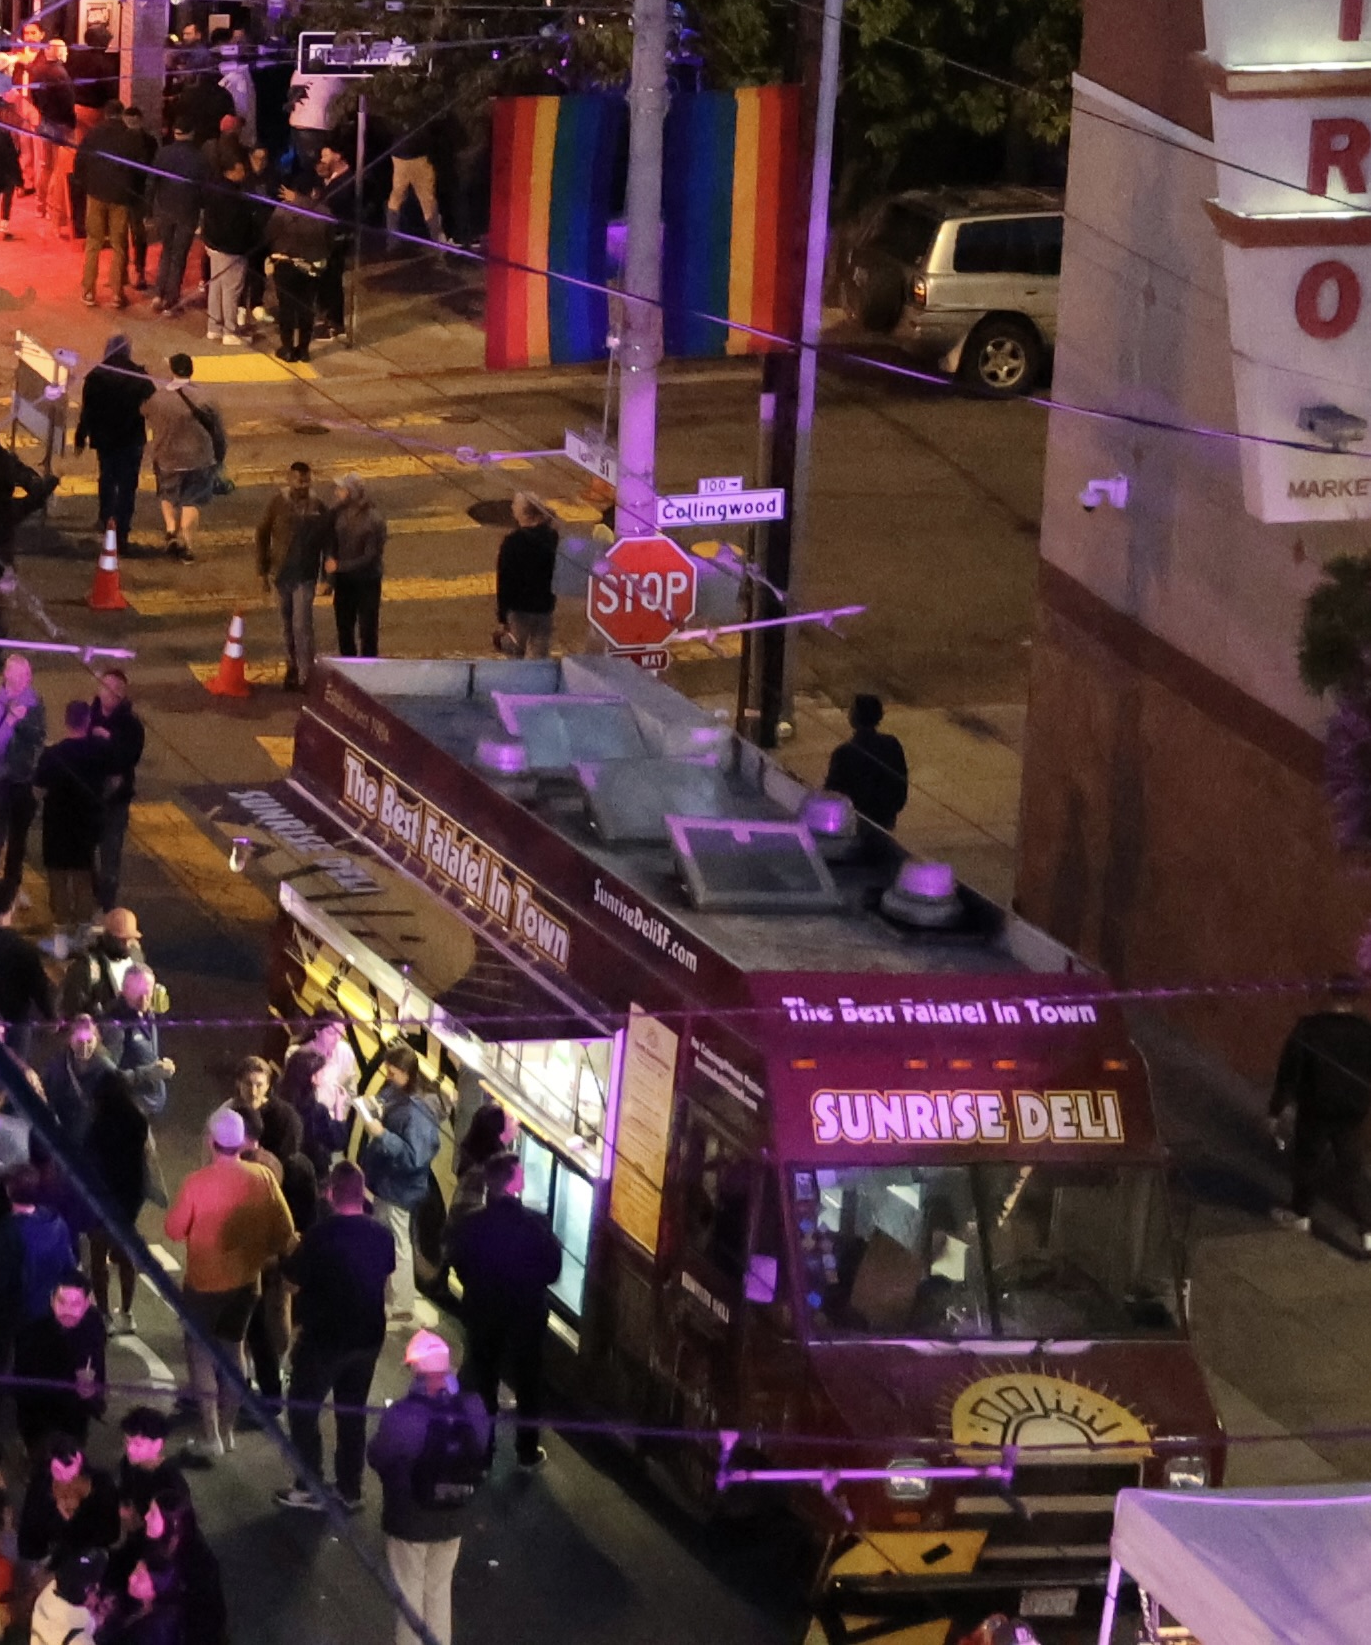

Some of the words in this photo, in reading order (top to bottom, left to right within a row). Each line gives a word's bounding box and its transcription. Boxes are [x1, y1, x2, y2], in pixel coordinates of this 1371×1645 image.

[703, 479, 726, 492] 100
[1287, 477, 1371, 498] MARKE
[662, 497, 776, 522] Collingwood
[597, 571, 688, 616] STOP
[641, 654, 664, 667] WAY
[227, 790, 336, 854] SUNRISE
[344, 754, 378, 815] The
[383, 780, 420, 845] Best
[424, 816, 487, 899] Falafel
[488, 865, 511, 919] In
[514, 884, 569, 964] Town
[593, 877, 698, 975] SunriseDeliSF.com
[782, 996, 834, 1022] The
[837, 997, 895, 1023] Best
[900, 999, 987, 1024] Falafel
[992, 1000, 1021, 1024] In
[1024, 999, 1097, 1024] Town
[813, 1092, 1007, 1141] SUNRISE
[1016, 1092, 1123, 1141] DELI
